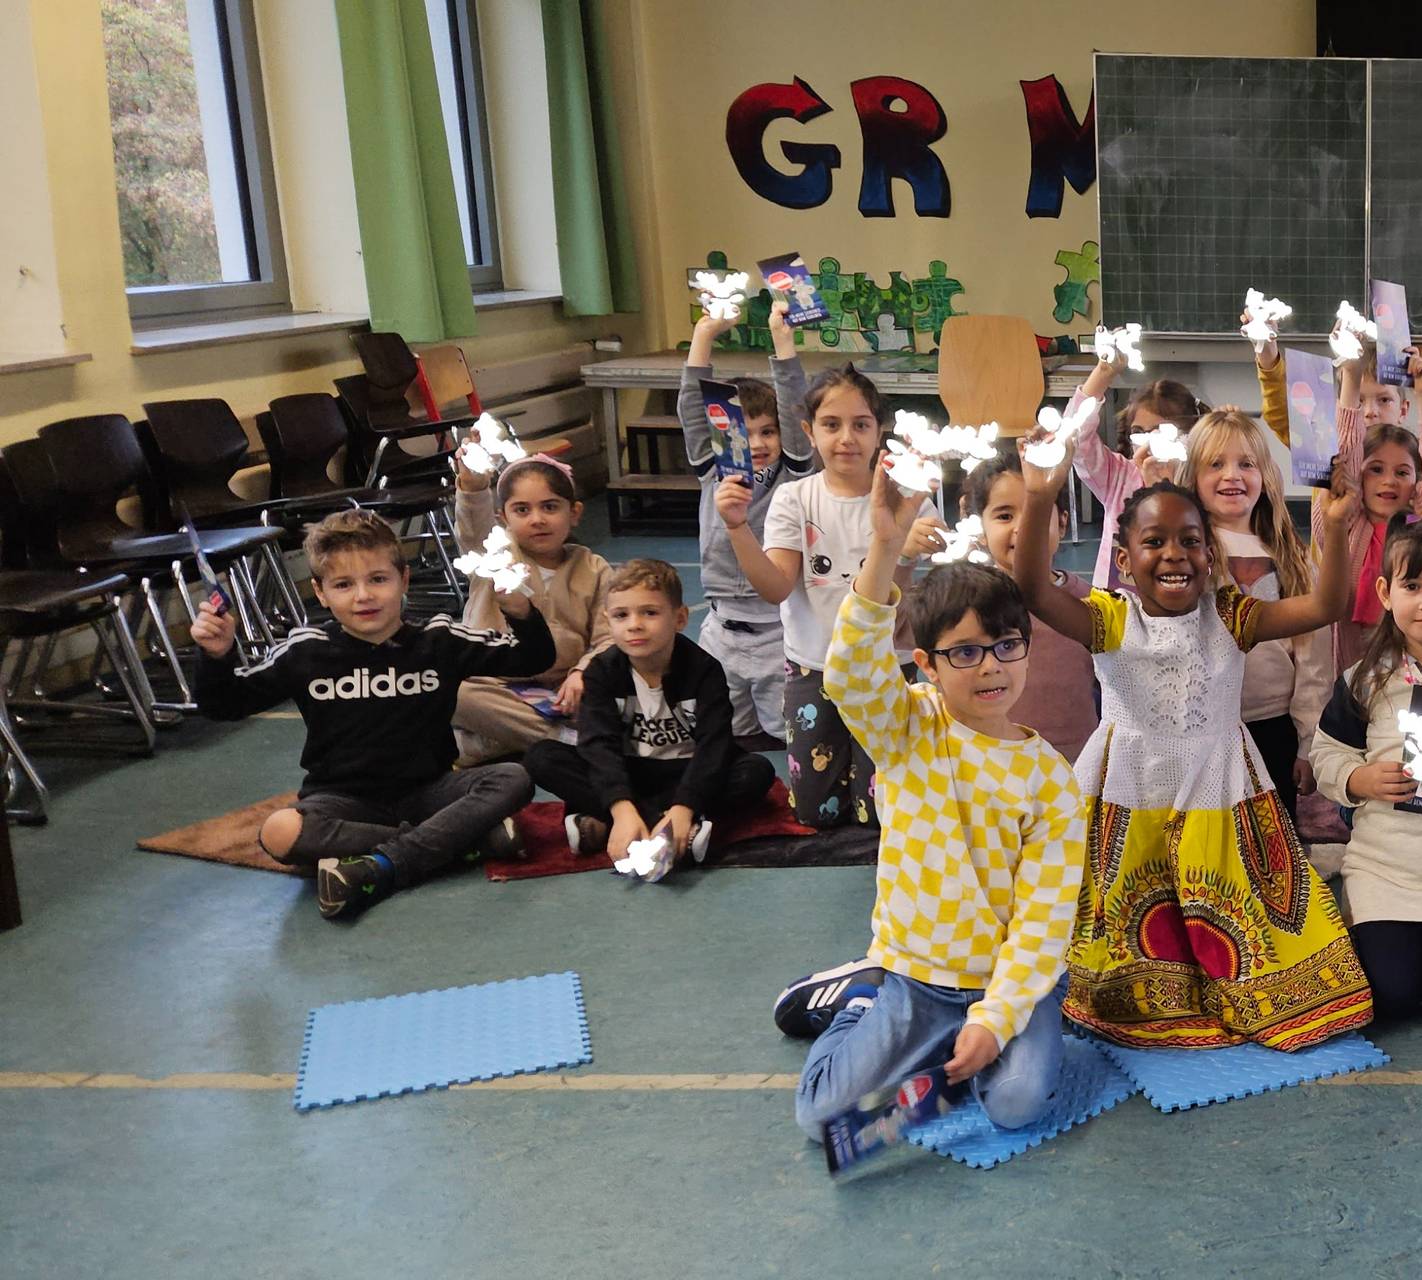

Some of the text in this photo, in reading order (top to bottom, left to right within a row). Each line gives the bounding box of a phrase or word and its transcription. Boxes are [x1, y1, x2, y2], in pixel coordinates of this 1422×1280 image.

[308, 667, 440, 701] adidas
[633, 712, 680, 733] RCKE
[630, 728, 690, 747] EGUE
